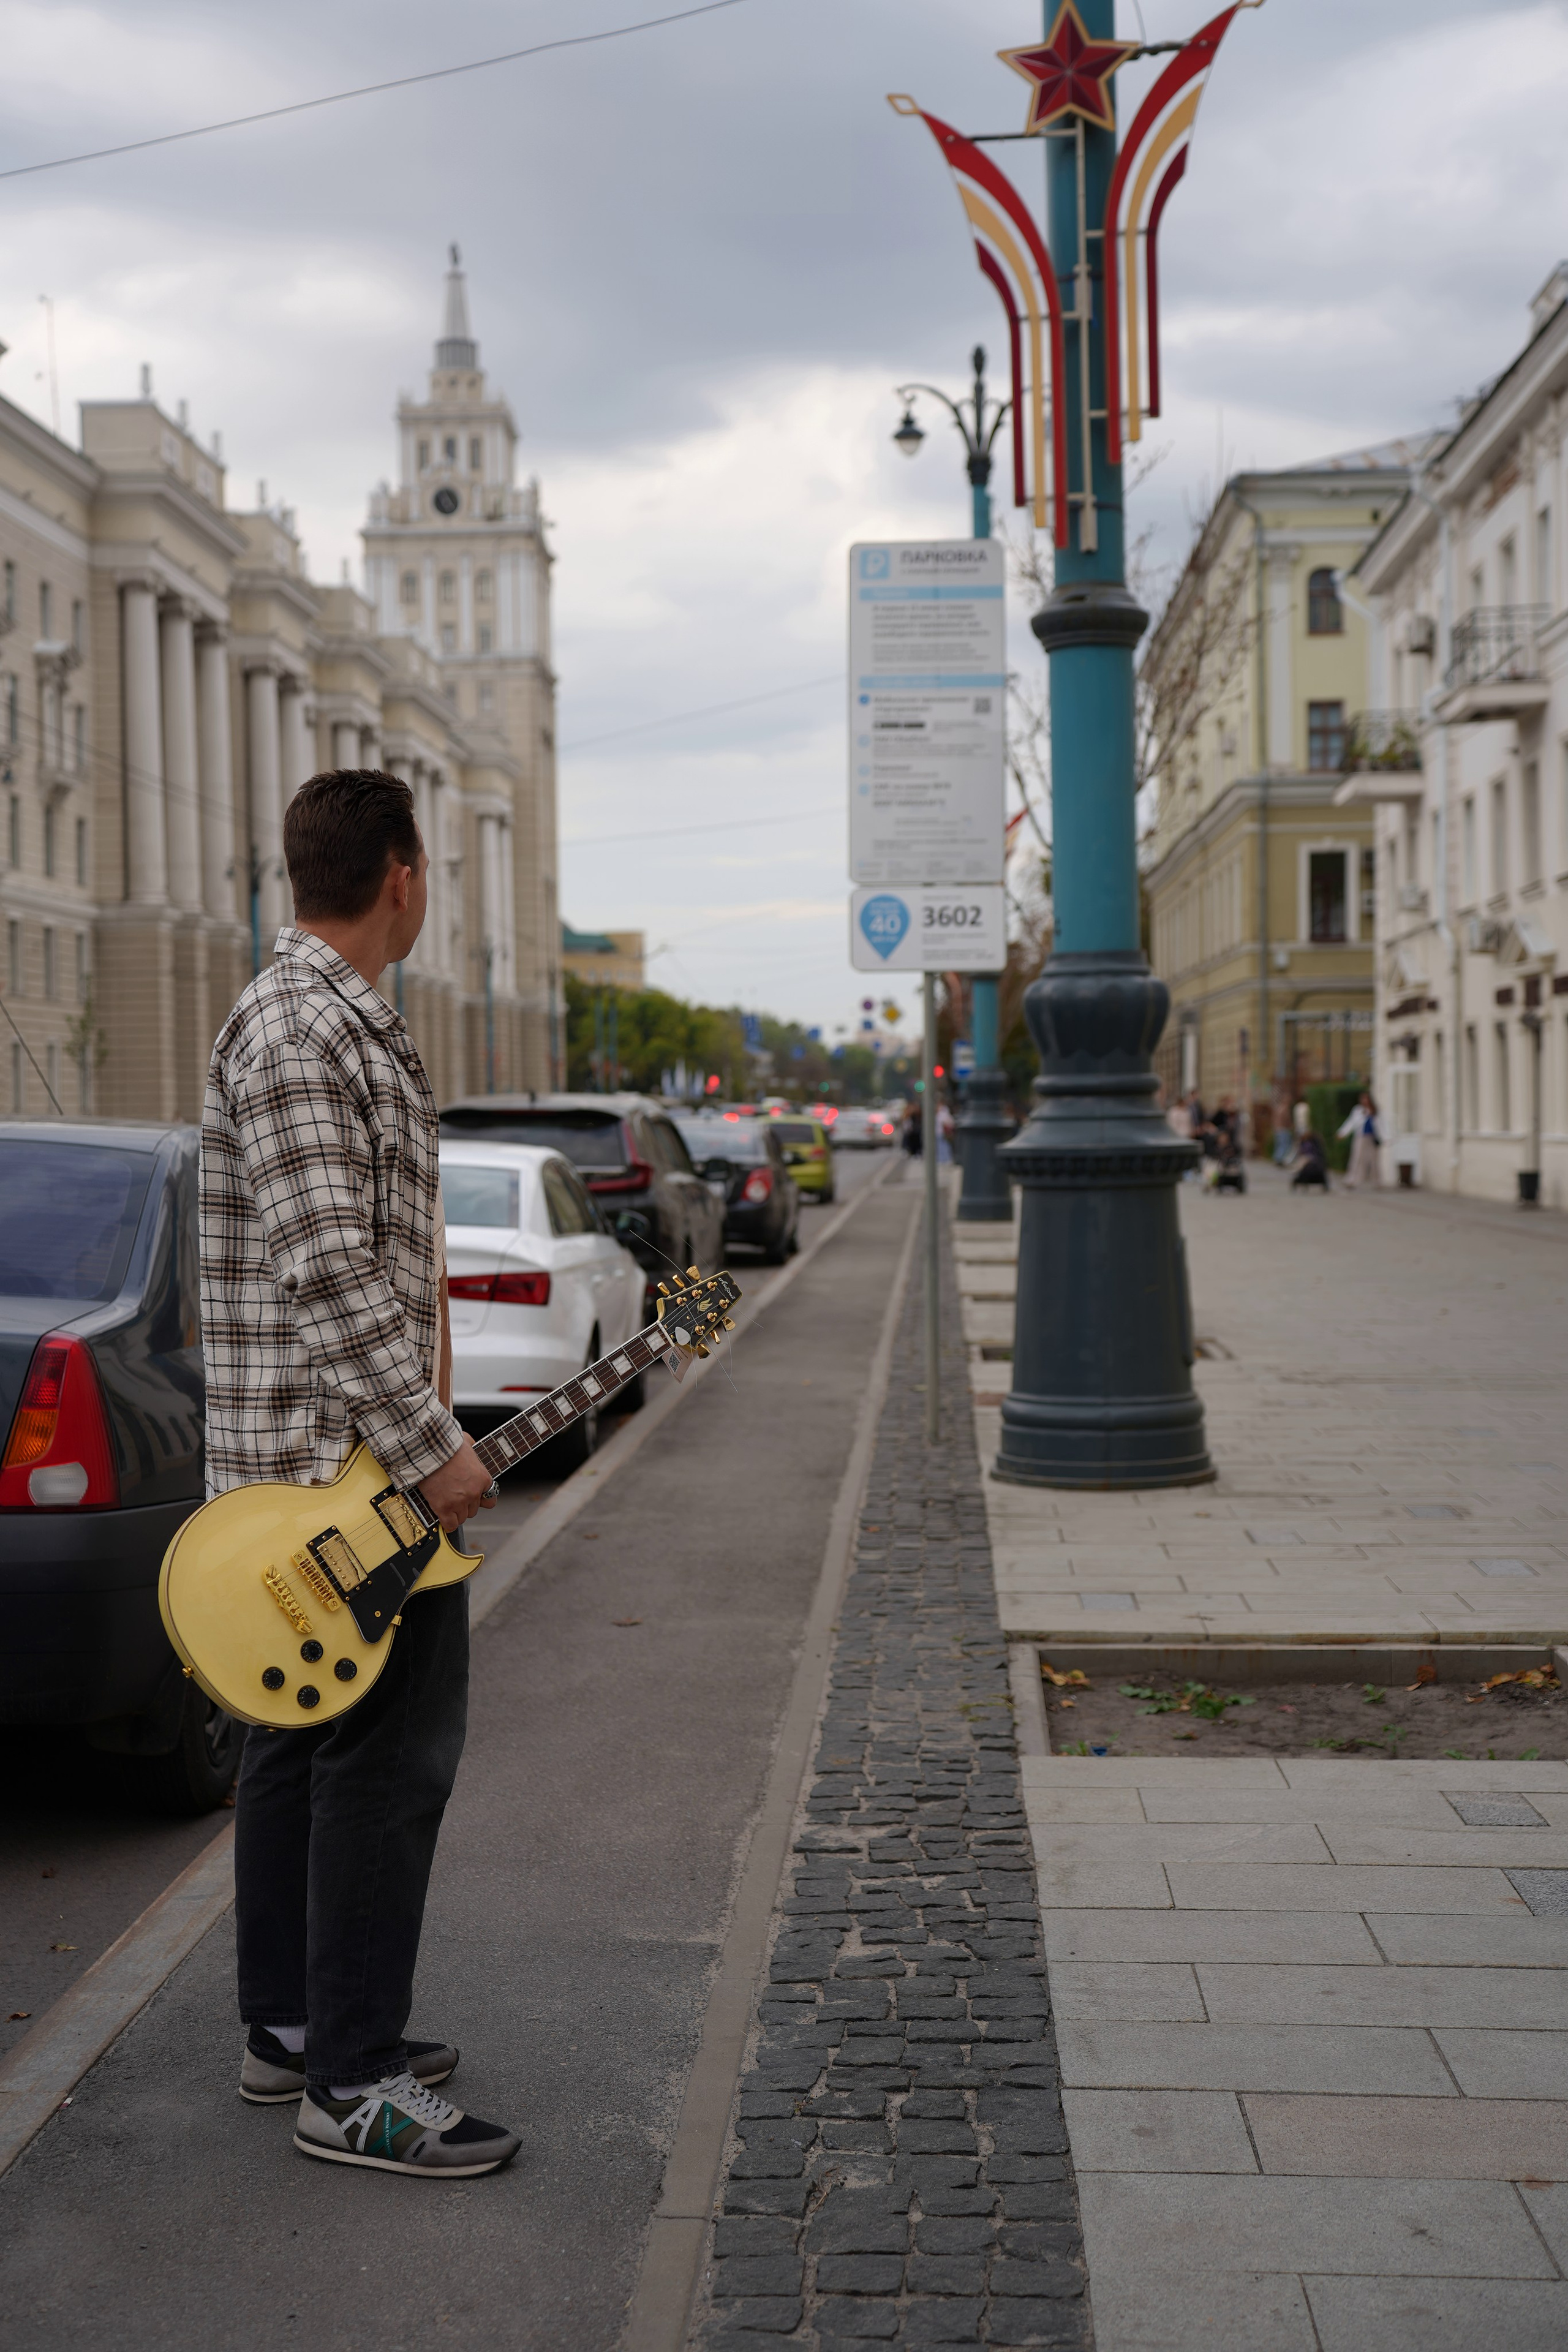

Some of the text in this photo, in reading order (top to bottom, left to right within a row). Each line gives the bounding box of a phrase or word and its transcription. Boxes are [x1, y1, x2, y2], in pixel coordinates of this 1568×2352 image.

[900, 549, 988, 565] ПАРКОВКА
[869, 913, 902, 935] 40
[922, 905, 982, 929] 3602
